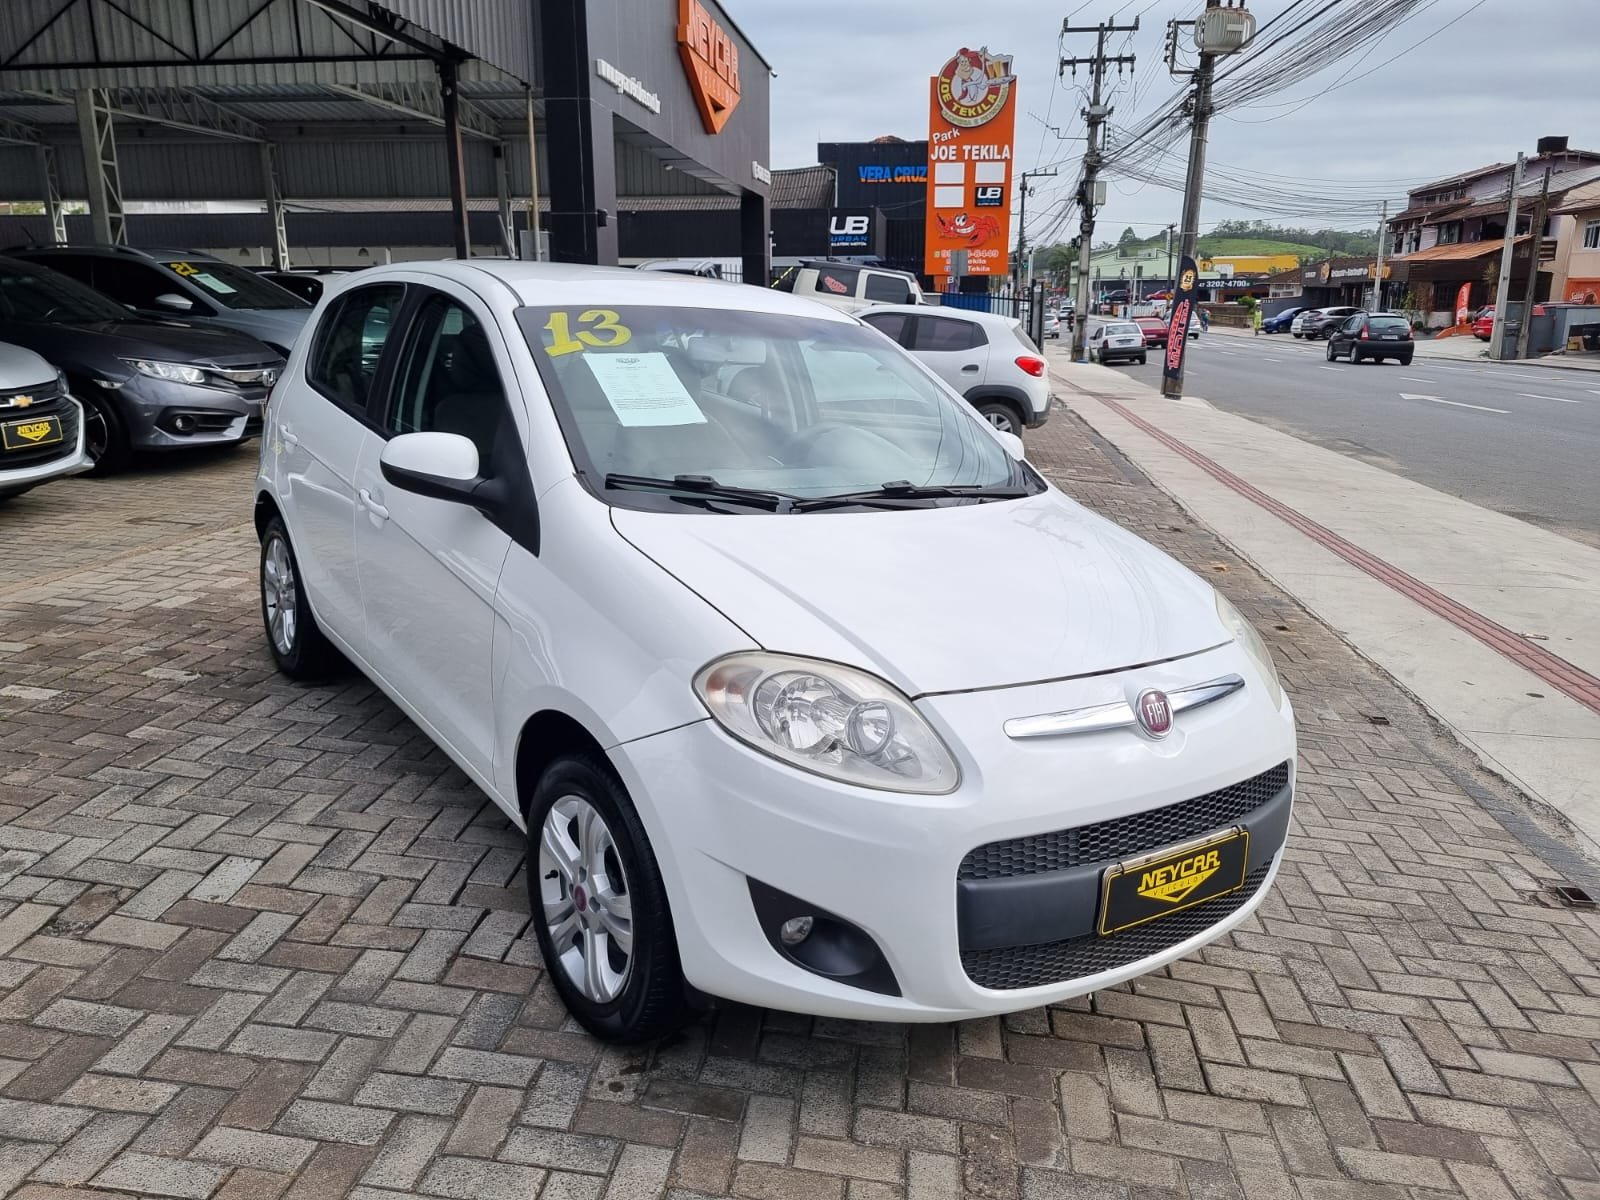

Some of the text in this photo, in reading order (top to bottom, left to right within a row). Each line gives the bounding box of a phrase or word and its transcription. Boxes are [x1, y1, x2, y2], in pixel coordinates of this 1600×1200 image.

[685, 0, 741, 95] NEYCAR
[940, 75, 953, 103] JOE
[951, 93, 997, 117] TEKILA
[932, 127, 961, 144] Park
[930, 144, 1011, 160] JOE TEKILA
[858, 166, 928, 182] VERA CRUZ
[977, 187, 1002, 199] UB
[829, 215, 870, 235] UB
[543, 309, 632, 357] 13
[17, 421, 52, 435] NEYCAR
[1146, 701, 1167, 725] FIAT
[1136, 849, 1221, 893] NEYCAR
[1153, 874, 1205, 896] VEICULOS
